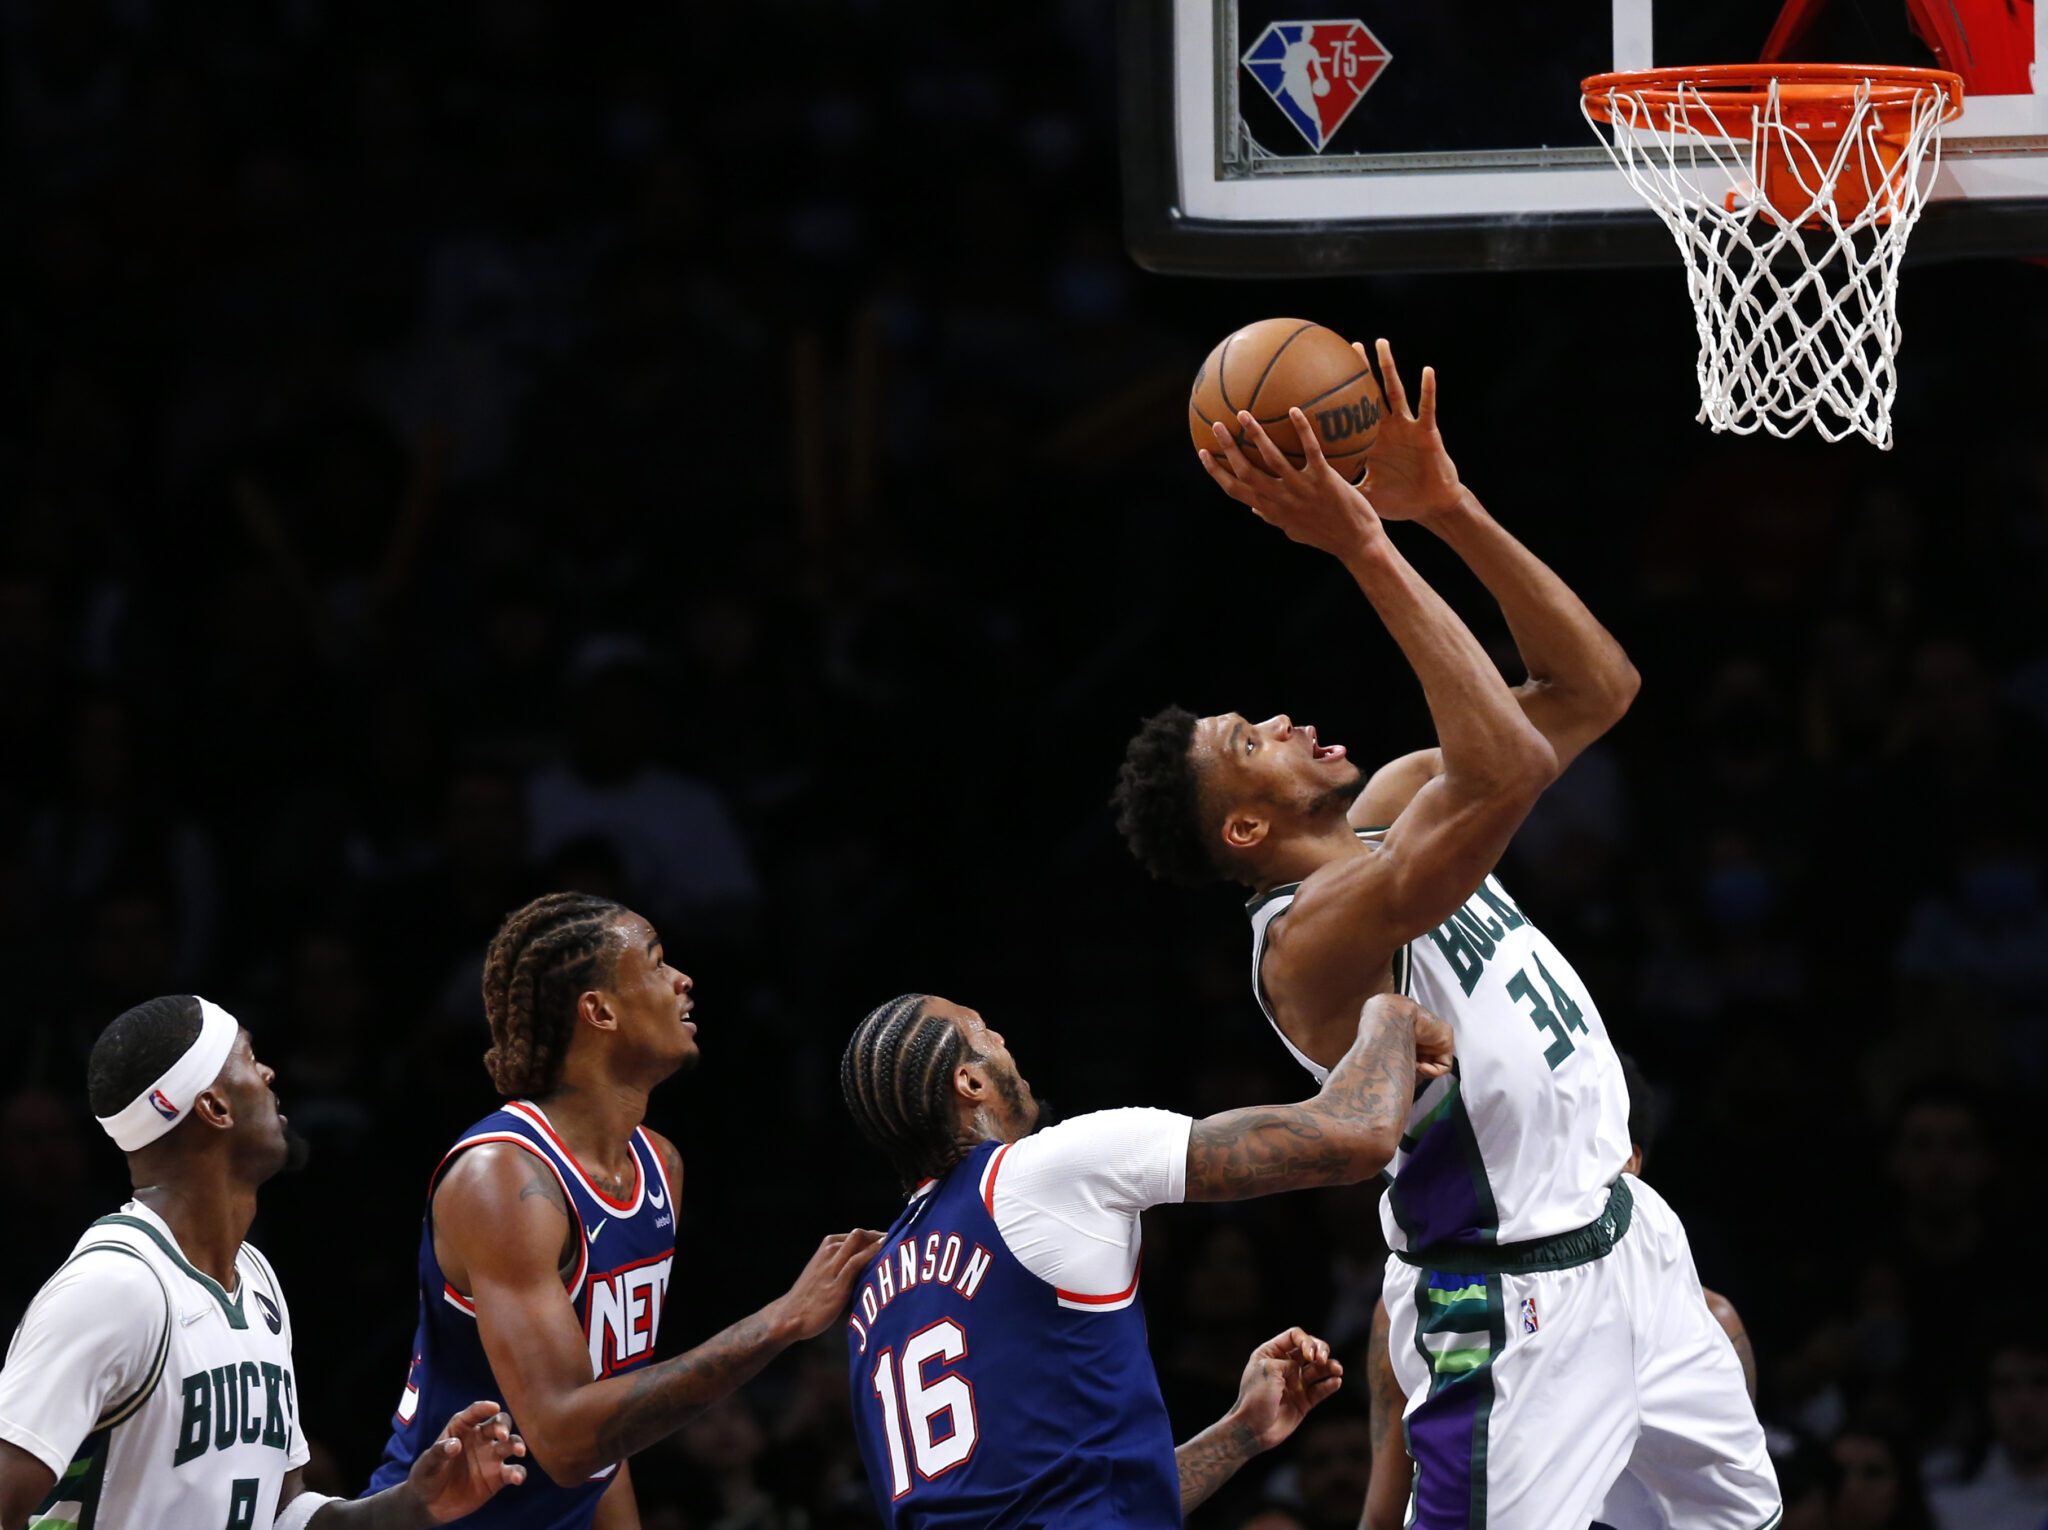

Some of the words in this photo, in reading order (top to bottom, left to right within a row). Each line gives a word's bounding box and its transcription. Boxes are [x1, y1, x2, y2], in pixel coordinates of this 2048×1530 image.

[1330, 41, 1357, 78] 75
[1428, 874, 1534, 998] BUCK
[1505, 950, 1590, 1072] 34
[584, 1248, 675, 1382] NET
[850, 1231, 994, 1355] JOHNSON
[871, 1316, 979, 1501] 16
